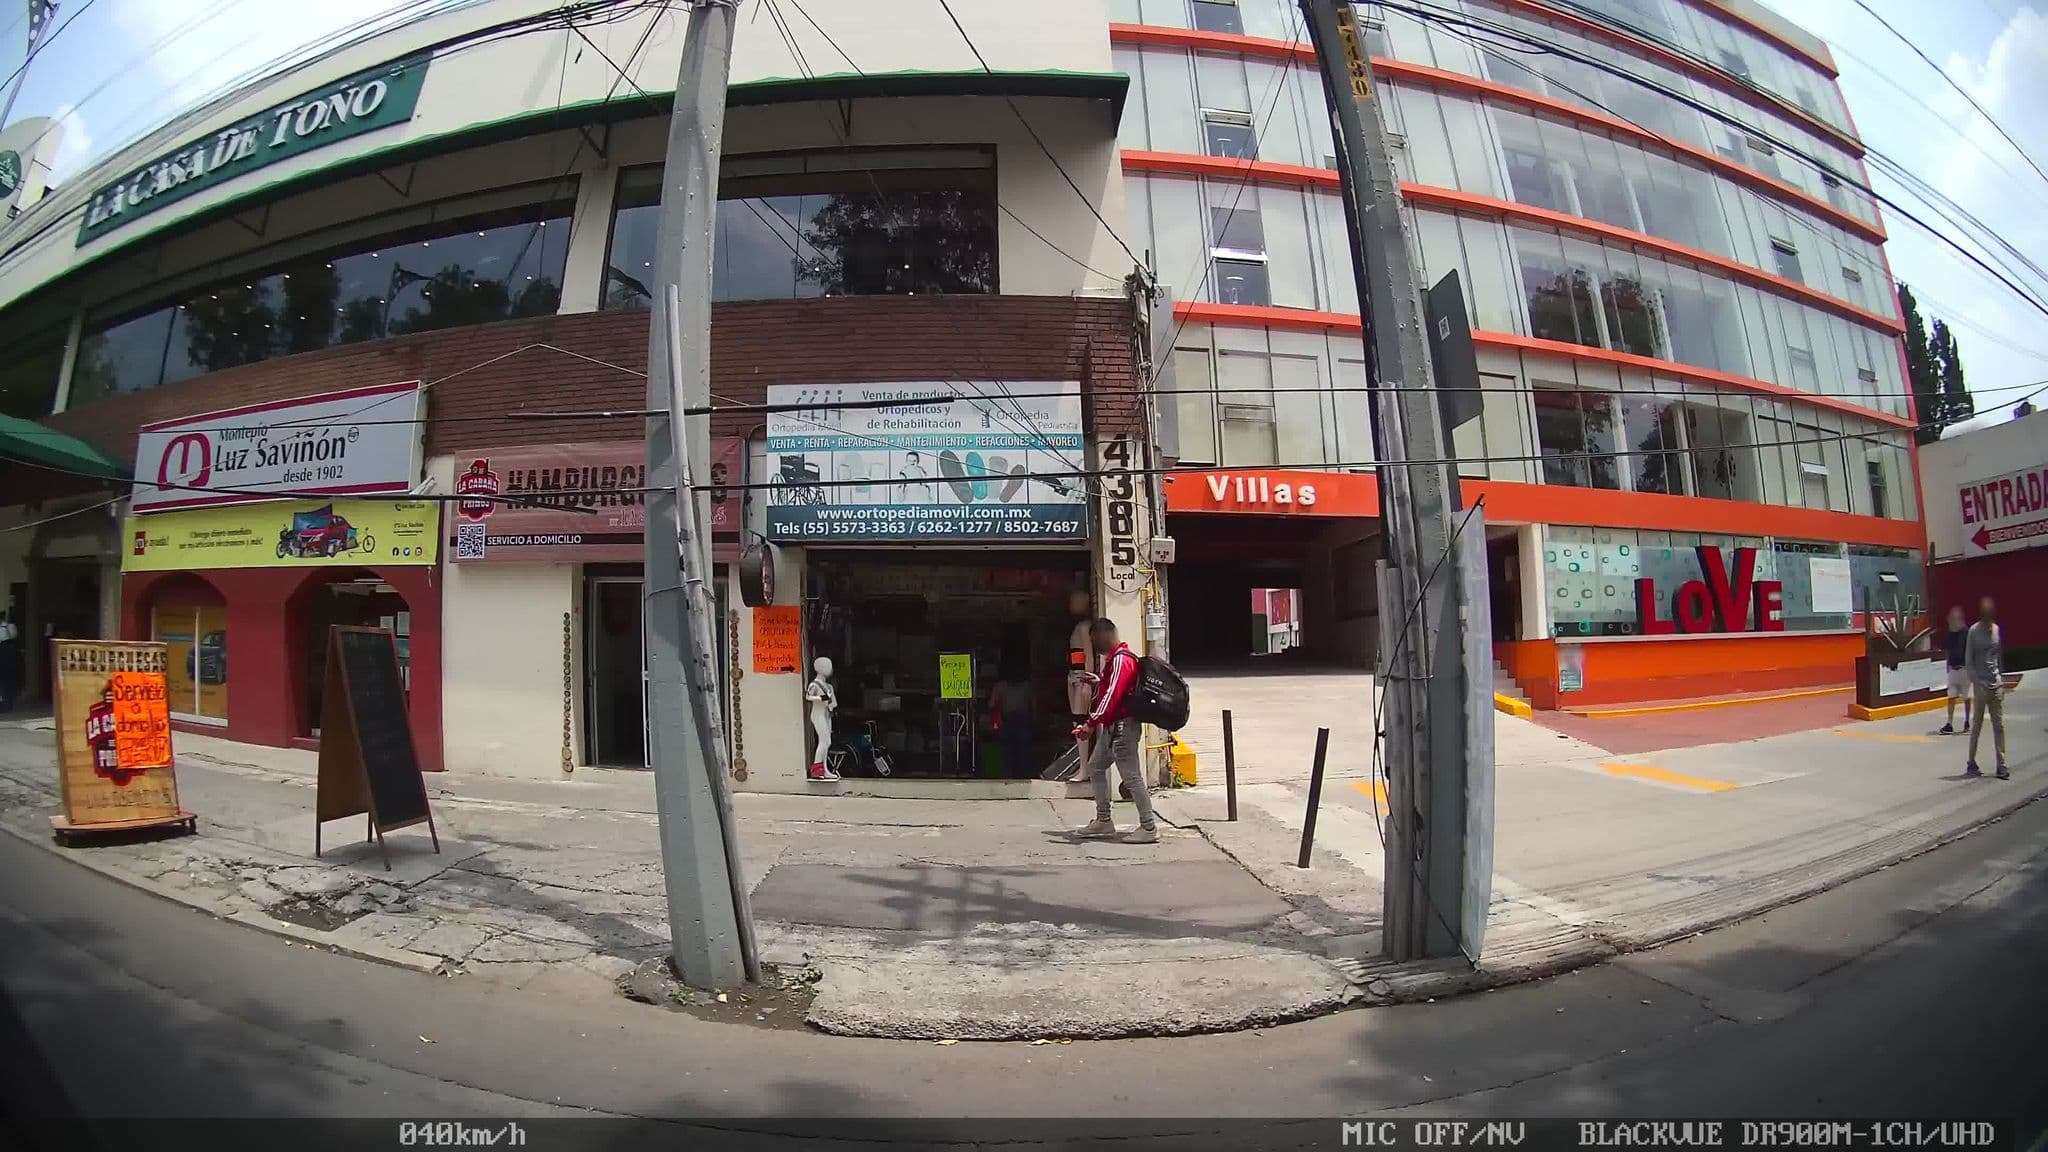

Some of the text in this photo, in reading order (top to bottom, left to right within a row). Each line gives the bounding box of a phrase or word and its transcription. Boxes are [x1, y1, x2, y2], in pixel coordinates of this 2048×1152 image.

[88, 185, 124, 228] LA
[129, 147, 205, 206] CASA
[209, 127, 263, 172] DE
[862, 390, 893, 400] Venta
[896, 389, 910, 399] de
[945, 406, 951, 416] y
[867, 419, 880, 429] de
[771, 439, 796, 449] VENTA
[804, 438, 830, 448] RENTA
[897, 436, 966, 447] MANTENIMIENTO
[975, 436, 1030, 447] REFACCIONES
[1038, 436, 1078, 447] MAYOREO
[214, 445, 250, 472] Luz
[255, 428, 346, 468] Saviñón
[283, 465, 343, 483] desde 1902
[1206, 475, 1316, 506] Villas
[1103, 433, 1136, 566] 4385
[817, 506, 1031, 521] www.ortopediamovil.com.mx
[774, 522, 800, 534] Tels
[803, 521, 829, 535] (55)
[832, 521, 906, 534] 5573-3363
[917, 521, 992, 534] 6262-1277
[1004, 521, 1078, 534] 8502-7687
[487, 535, 582, 546] SERVICIO A DOMICILIO
[1110, 567, 1135, 581] Local
